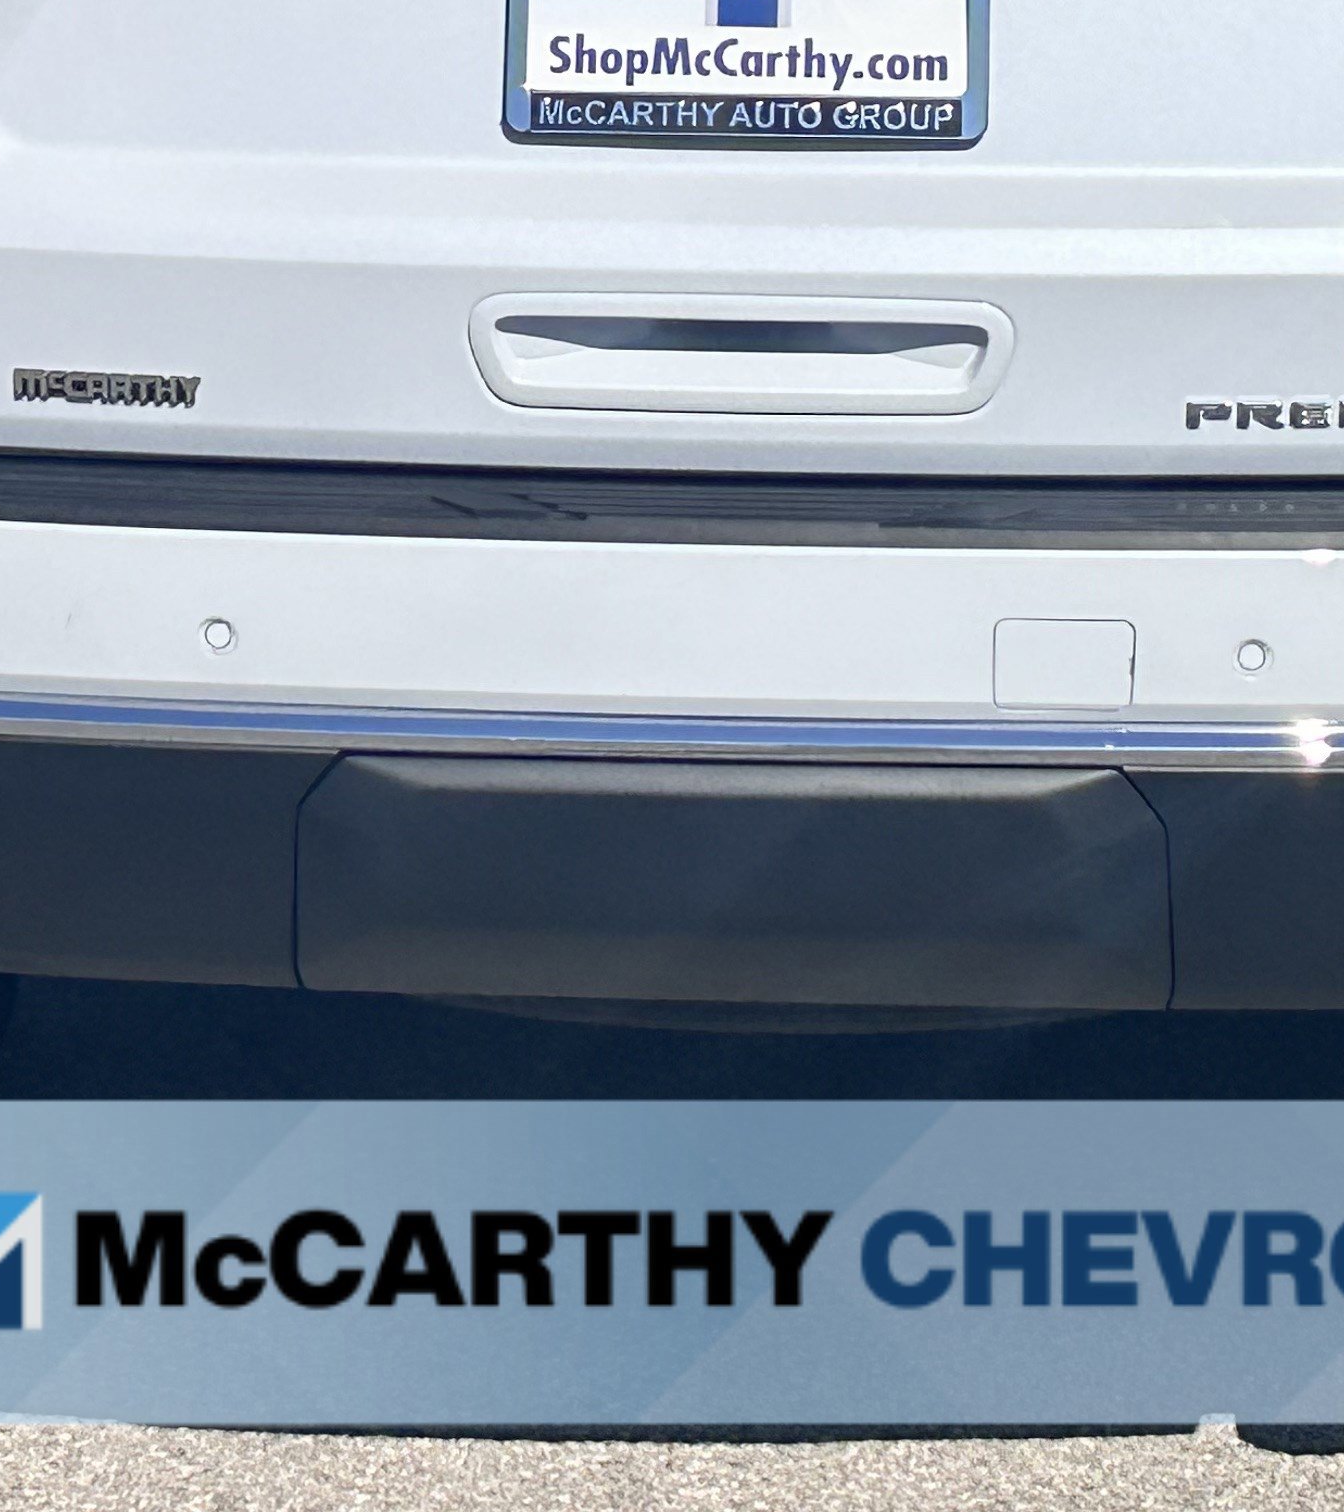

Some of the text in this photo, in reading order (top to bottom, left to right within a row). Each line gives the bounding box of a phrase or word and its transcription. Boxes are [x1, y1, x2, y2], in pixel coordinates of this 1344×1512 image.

[549, 33, 949, 91] ShopMcCarthy.com
[538, 96, 954, 132] McCARTHY AUTO GROUP
